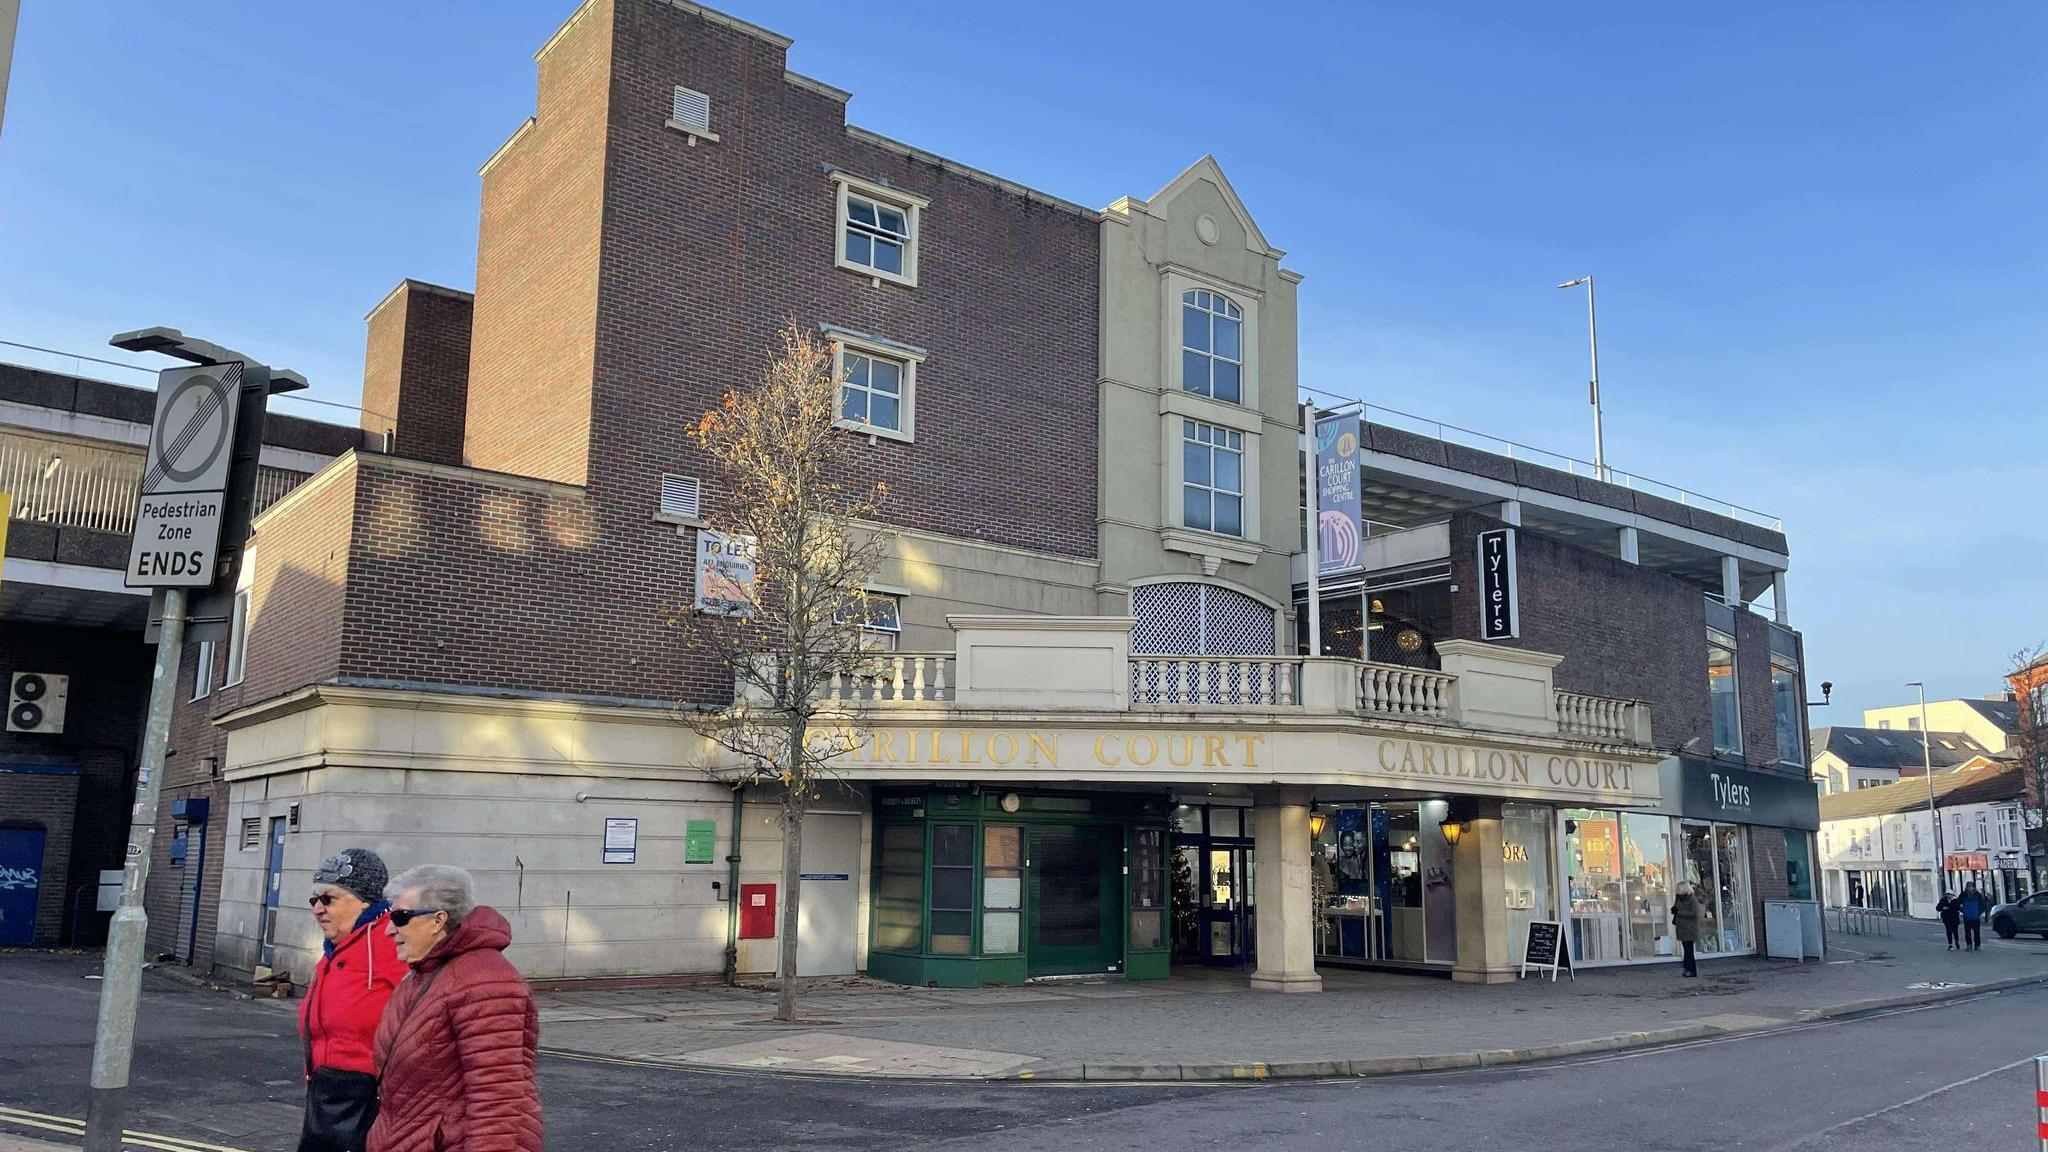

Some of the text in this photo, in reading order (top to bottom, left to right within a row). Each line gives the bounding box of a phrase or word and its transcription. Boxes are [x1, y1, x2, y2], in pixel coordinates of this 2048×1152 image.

[1320, 460, 1355, 477] CARILLON
[1327, 471, 1351, 487] COURT
[143, 501, 217, 519] Pedestrian
[158, 524, 192, 540] Zone
[704, 540, 721, 554] TO
[137, 551, 203, 576] ENDS
[1489, 538, 1503, 630] Tylers
[801, 728, 1265, 768] CARILLON COURT
[1378, 739, 1633, 790] CARILLON COURT
[1711, 773, 1750, 810] Tylers
